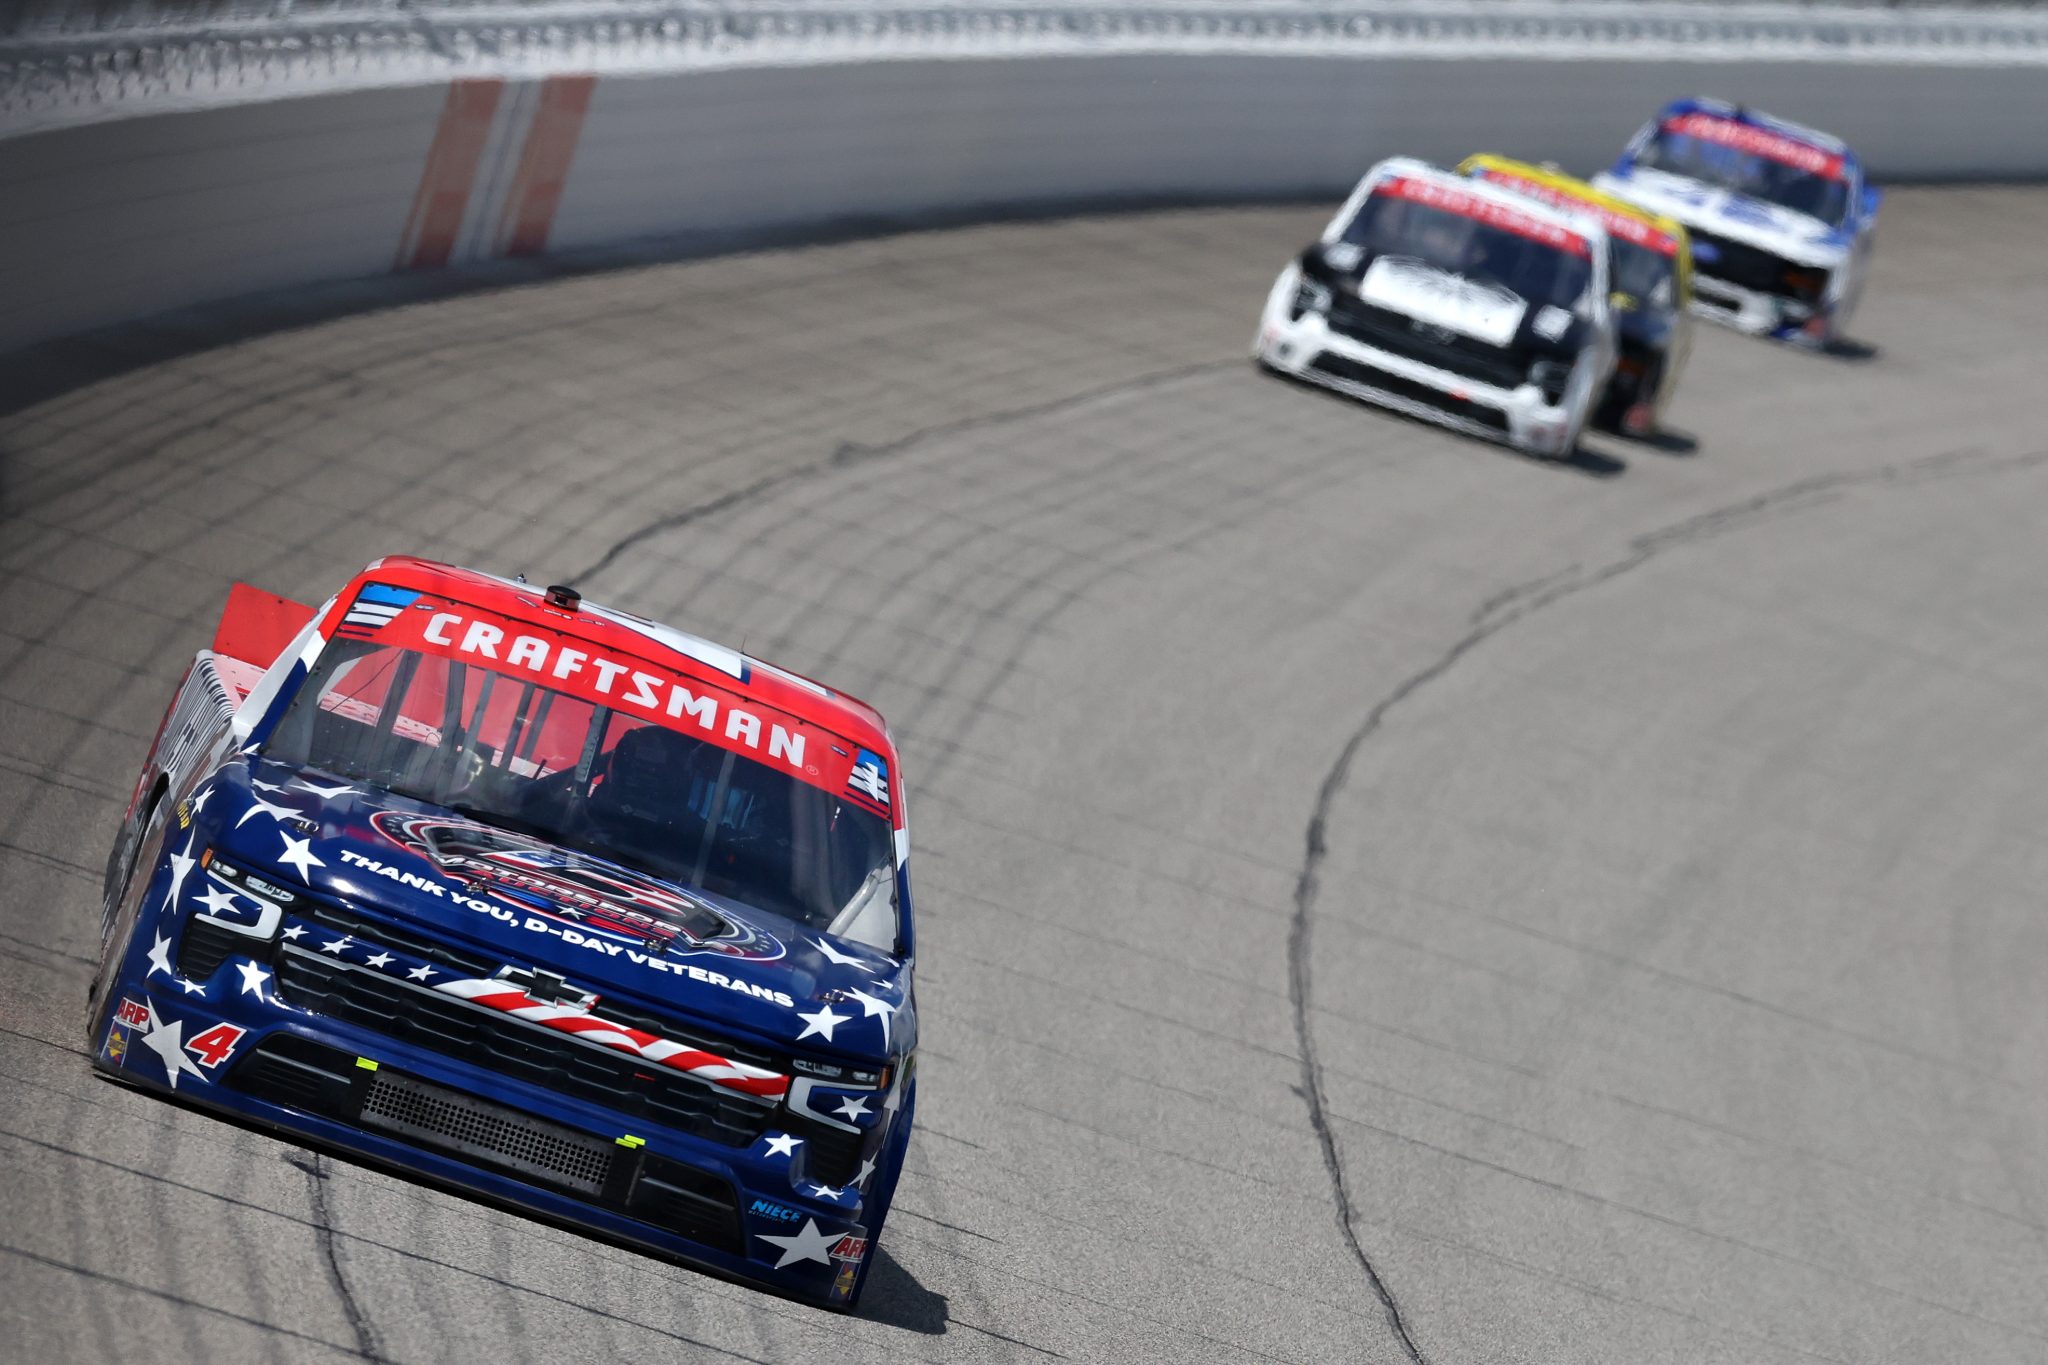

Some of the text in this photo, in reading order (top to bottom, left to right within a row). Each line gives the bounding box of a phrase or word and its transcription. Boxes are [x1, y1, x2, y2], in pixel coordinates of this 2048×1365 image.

[423, 613, 806, 768] CRAFTSMAN
[340, 850, 795, 1007] THANK YOU, D-DAY VETERANS
[117, 999, 149, 1025] ARP
[186, 1023, 246, 1068] 4
